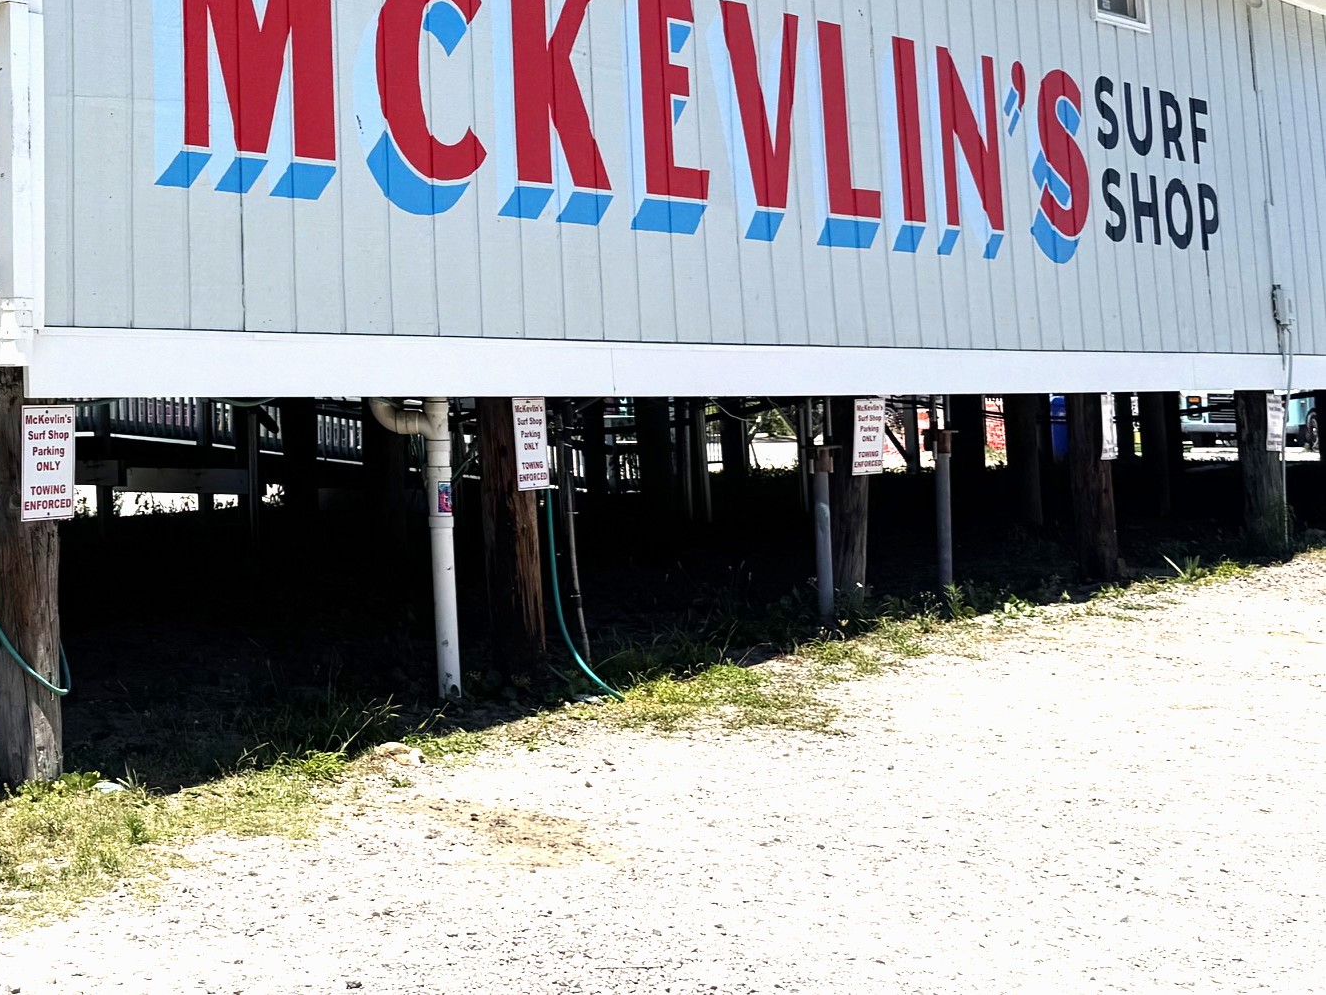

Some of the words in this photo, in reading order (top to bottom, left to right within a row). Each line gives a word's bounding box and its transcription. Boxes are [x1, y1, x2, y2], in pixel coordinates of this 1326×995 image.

[1094, 76, 1209, 164] SURF
[1102, 167, 1219, 251] SHOP
[514, 405, 543, 413] McKevlin's
[25, 414, 72, 424] McKevlin's
[517, 417, 528, 425] Surf
[529, 417, 542, 426] Shop
[28, 430, 46, 440] Surf
[48, 430, 69, 441] Shop
[521, 430, 541, 439] Parking
[32, 446, 65, 457] Parking
[36, 461, 61, 471] ONLY
[522, 461, 544, 470] TOWING
[519, 472, 547, 482] ENFORCED
[30, 484, 66, 495] TOWING
[24, 498, 71, 510] ENFORCED
